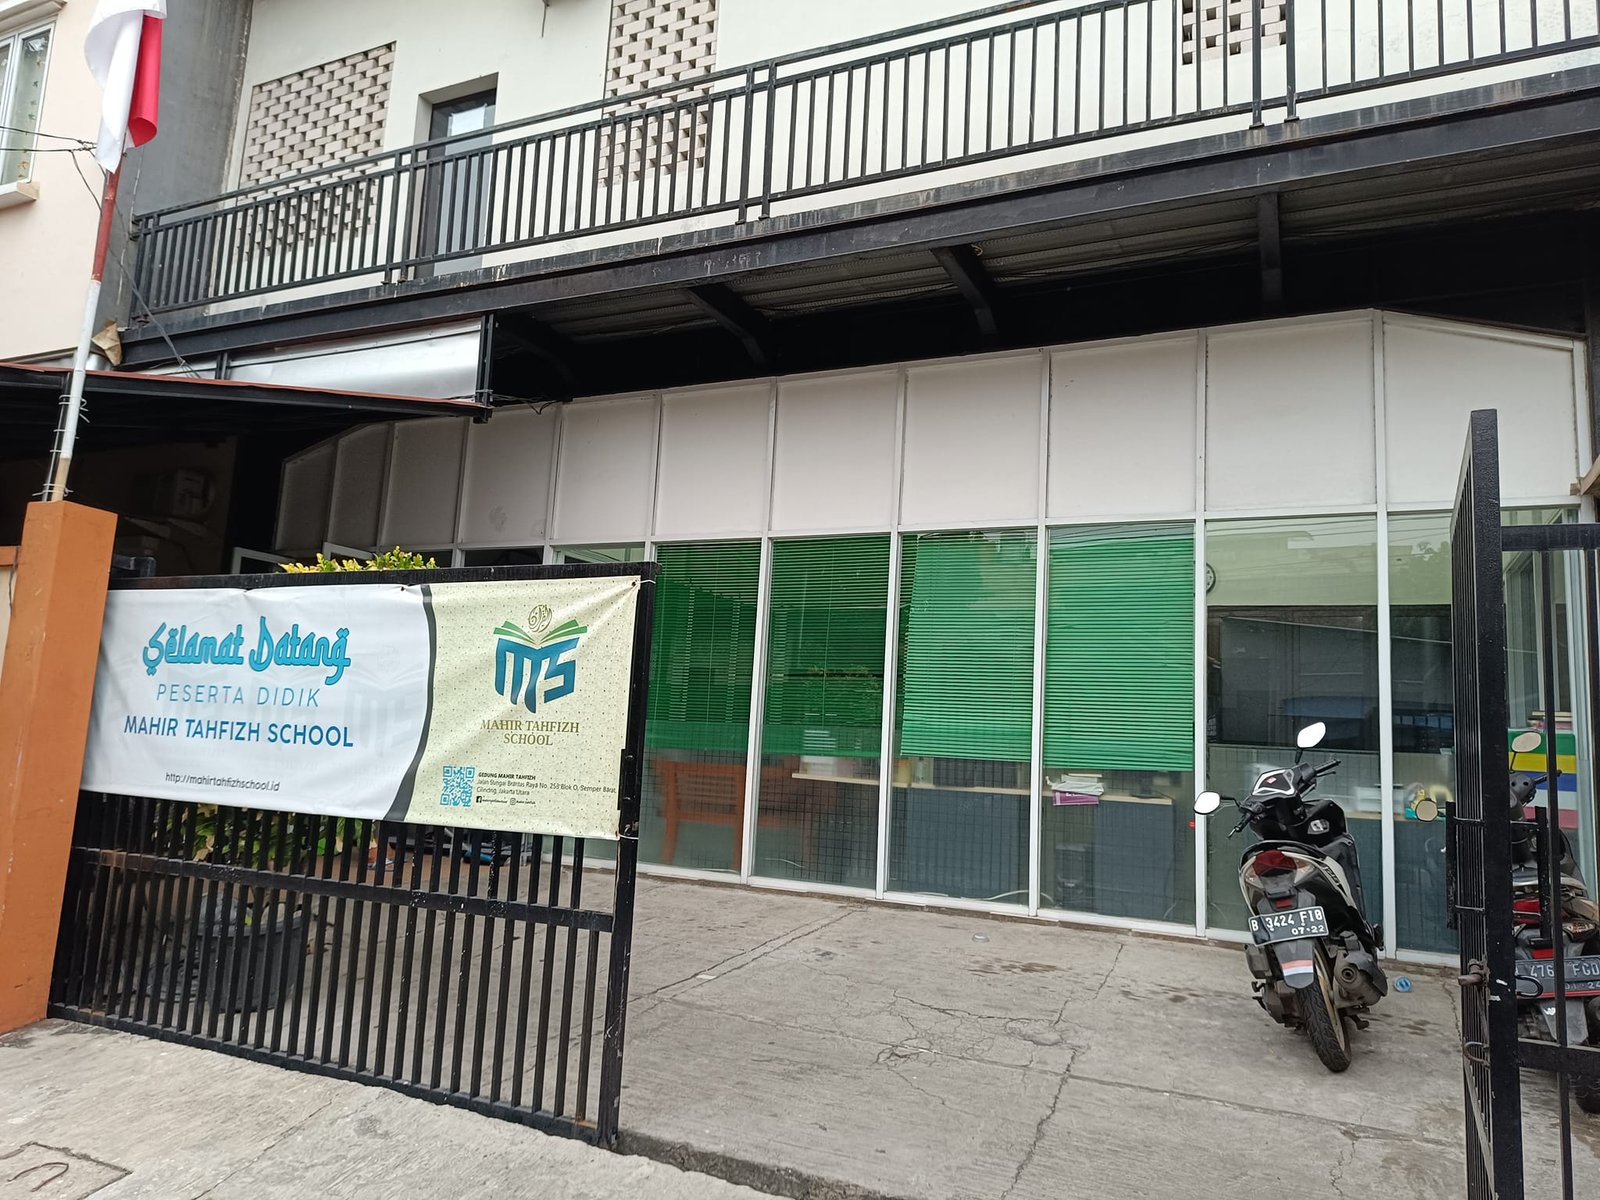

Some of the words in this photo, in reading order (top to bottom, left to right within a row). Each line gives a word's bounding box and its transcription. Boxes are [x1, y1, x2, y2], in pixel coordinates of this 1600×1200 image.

[156, 683, 244, 705] PESERTA
[256, 687, 321, 708] DIDIK
[124, 715, 179, 737] MAHIR
[185, 719, 260, 742] TAHFIZH
[267, 723, 354, 748] SCHOOL
[480, 719, 522, 731] MAHIR
[526, 720, 580, 733] TAHFIZH
[503, 733, 553, 746] SCHOOL
[165, 772, 281, 792] http://mahirtahfizhschool.id
[1250, 919, 1259, 932] B
[1265, 914, 1295, 930] 3424
[1530, 964, 1557, 978] 476
